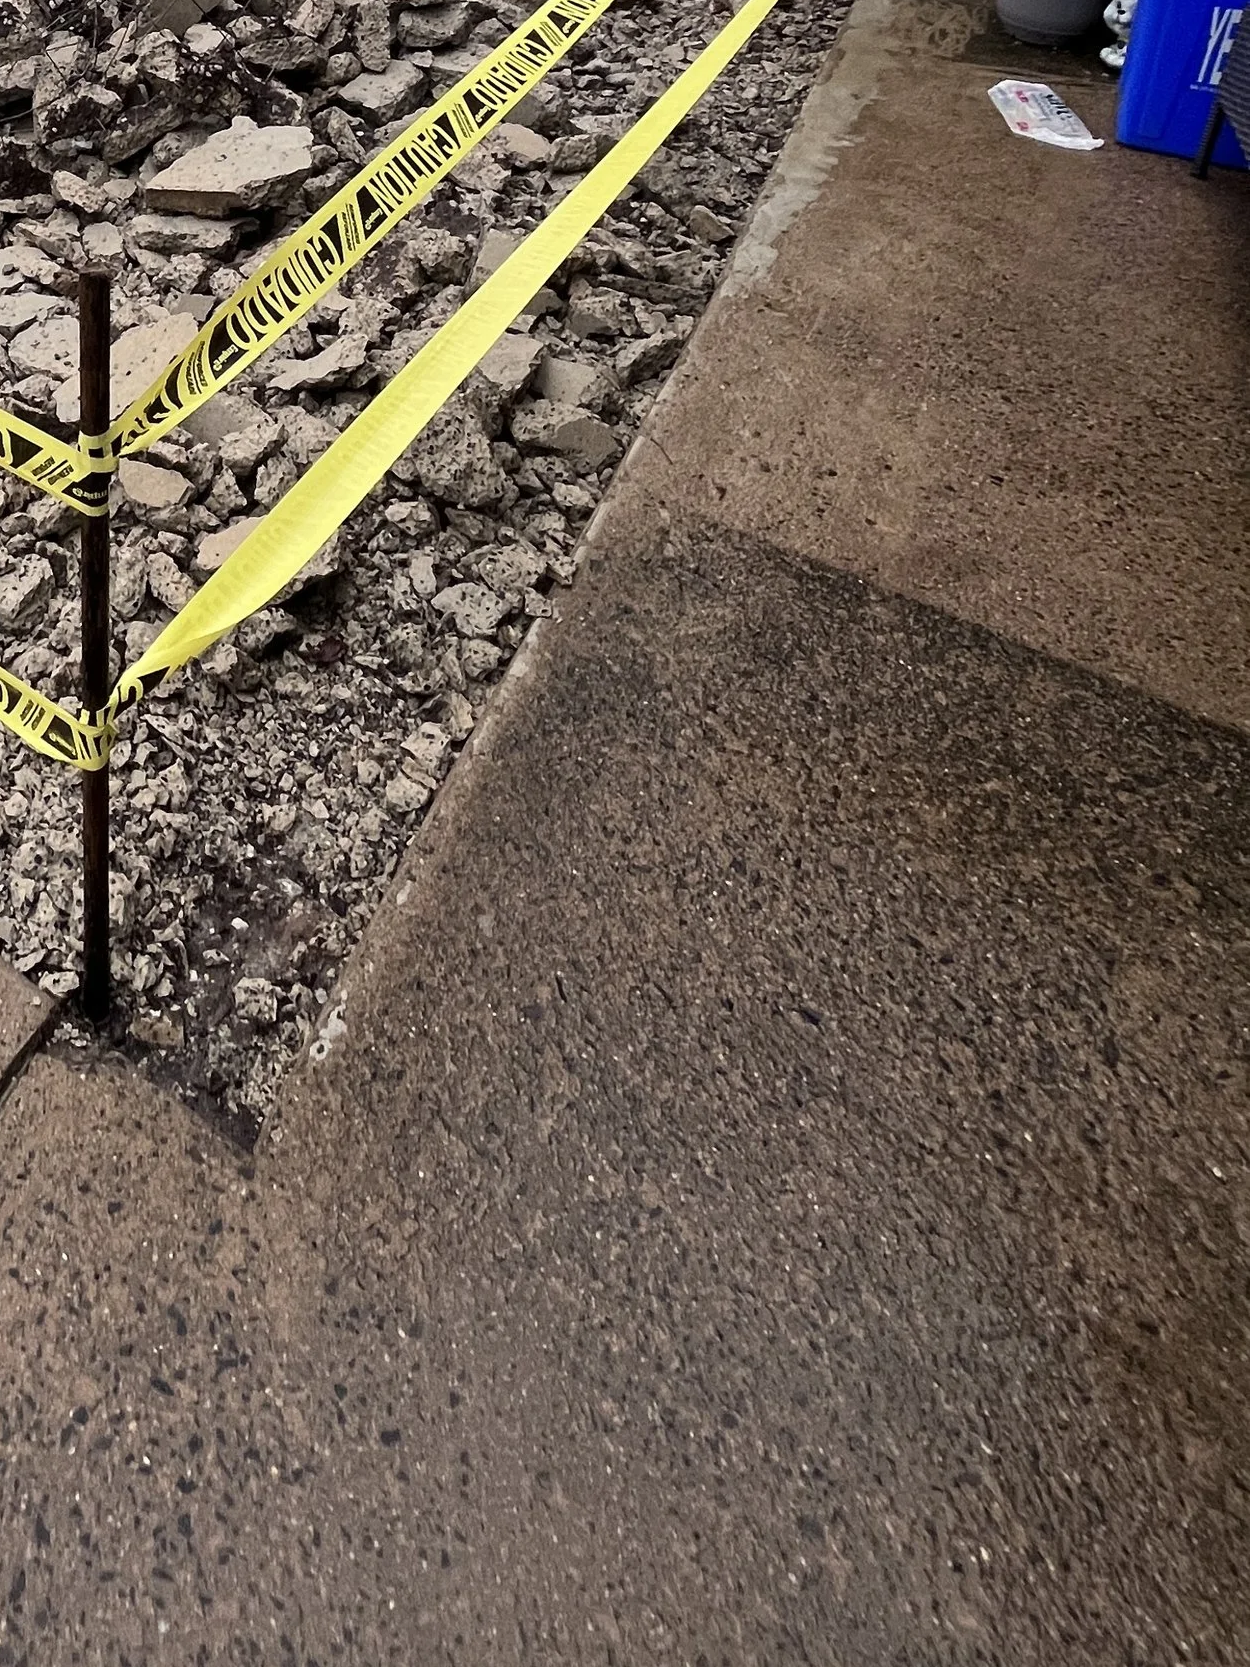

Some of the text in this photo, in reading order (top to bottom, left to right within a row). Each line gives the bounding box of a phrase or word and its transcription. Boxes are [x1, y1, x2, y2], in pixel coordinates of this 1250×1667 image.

[473, 40, 551, 108] CUIDADO
[369, 122, 457, 216] CAUTION
[223, 232, 345, 351] CUIDADO
[210, 343, 239, 372] Empire
